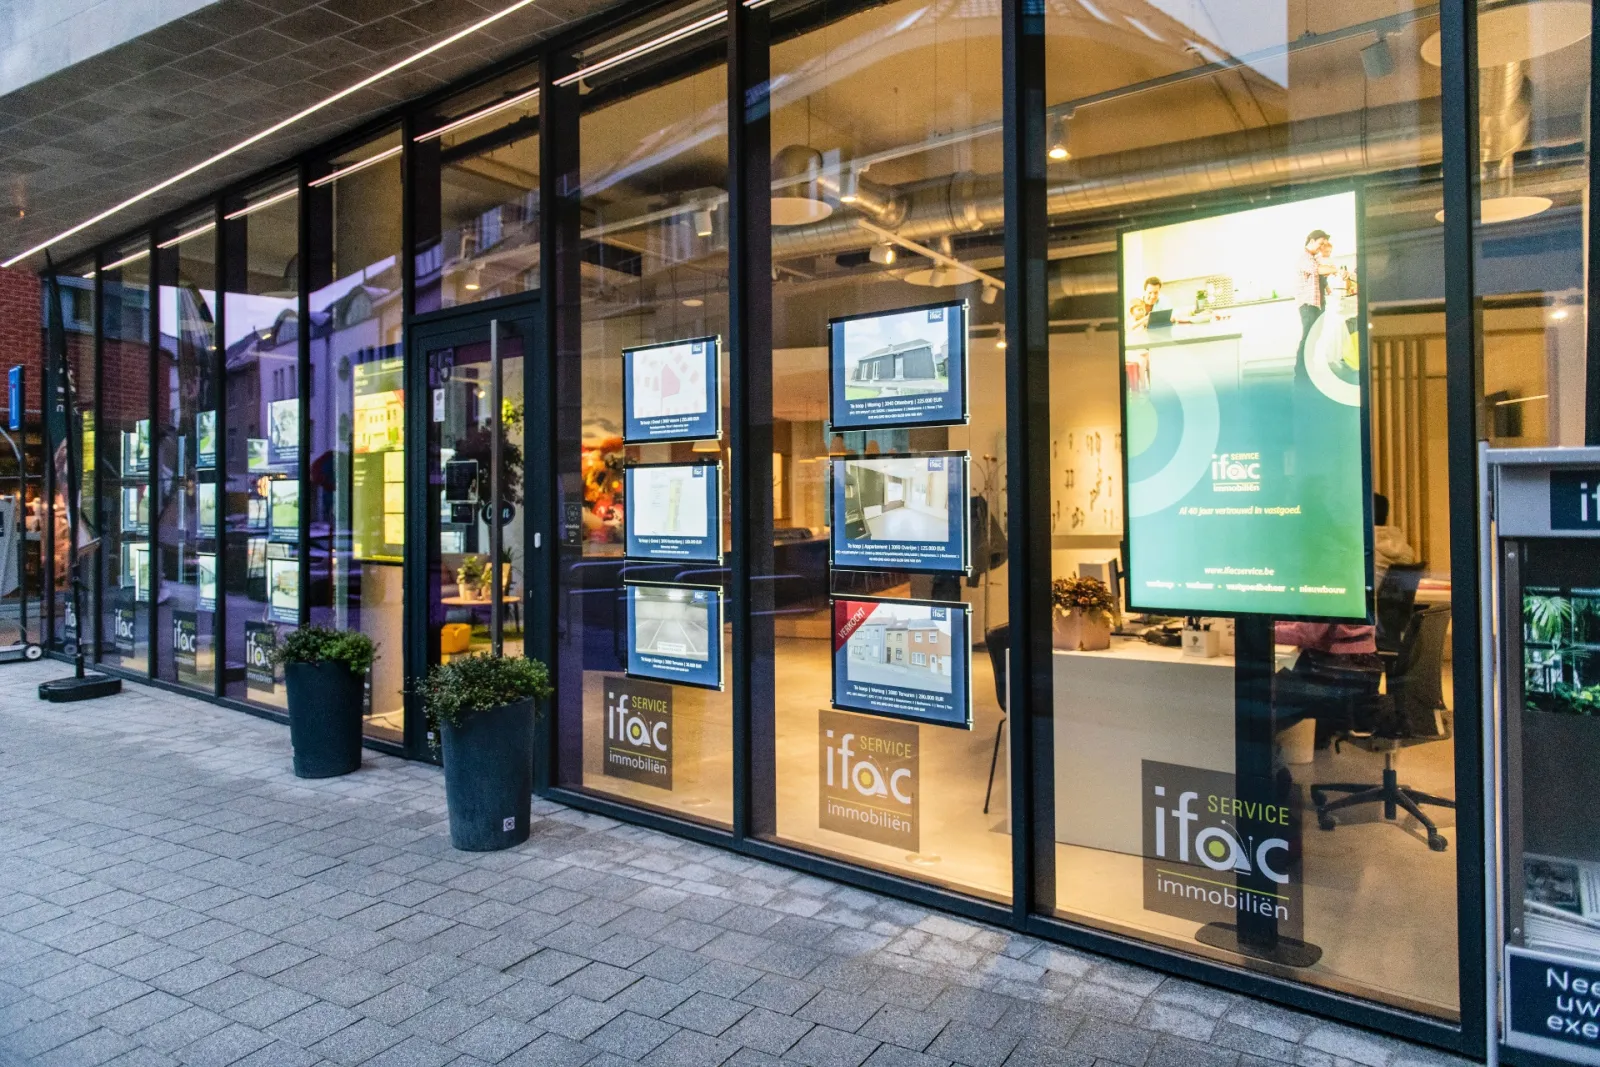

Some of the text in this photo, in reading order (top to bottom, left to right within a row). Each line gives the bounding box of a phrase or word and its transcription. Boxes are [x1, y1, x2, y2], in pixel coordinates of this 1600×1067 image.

[1212, 454, 1260, 480] ifac
[1231, 452, 1260, 460] SERVICE
[1198, 507, 1214, 516] jaar
[1215, 506, 1253, 515] vertrouwd
[1254, 506, 1262, 514] in
[1264, 505, 1301, 516] vastgoed.
[1299, 585, 1346, 594] nieuwbouw
[838, 606, 866, 638] VERKOCHT
[174, 619, 195, 652] ifac
[632, 696, 667, 714] SERVICE
[608, 692, 667, 751] ifac
[860, 735, 911, 759] SERVICE
[610, 750, 667, 775] immobiliën
[827, 730, 911, 804] ifac
[827, 800, 911, 833] immobiliën
[1208, 794, 1289, 826] SERVICE
[1155, 786, 1289, 884] ifac
[1158, 874, 1288, 920] immobiliën
[1557, 995, 1600, 1017] uw
[1547, 1015, 1599, 1038] exe
